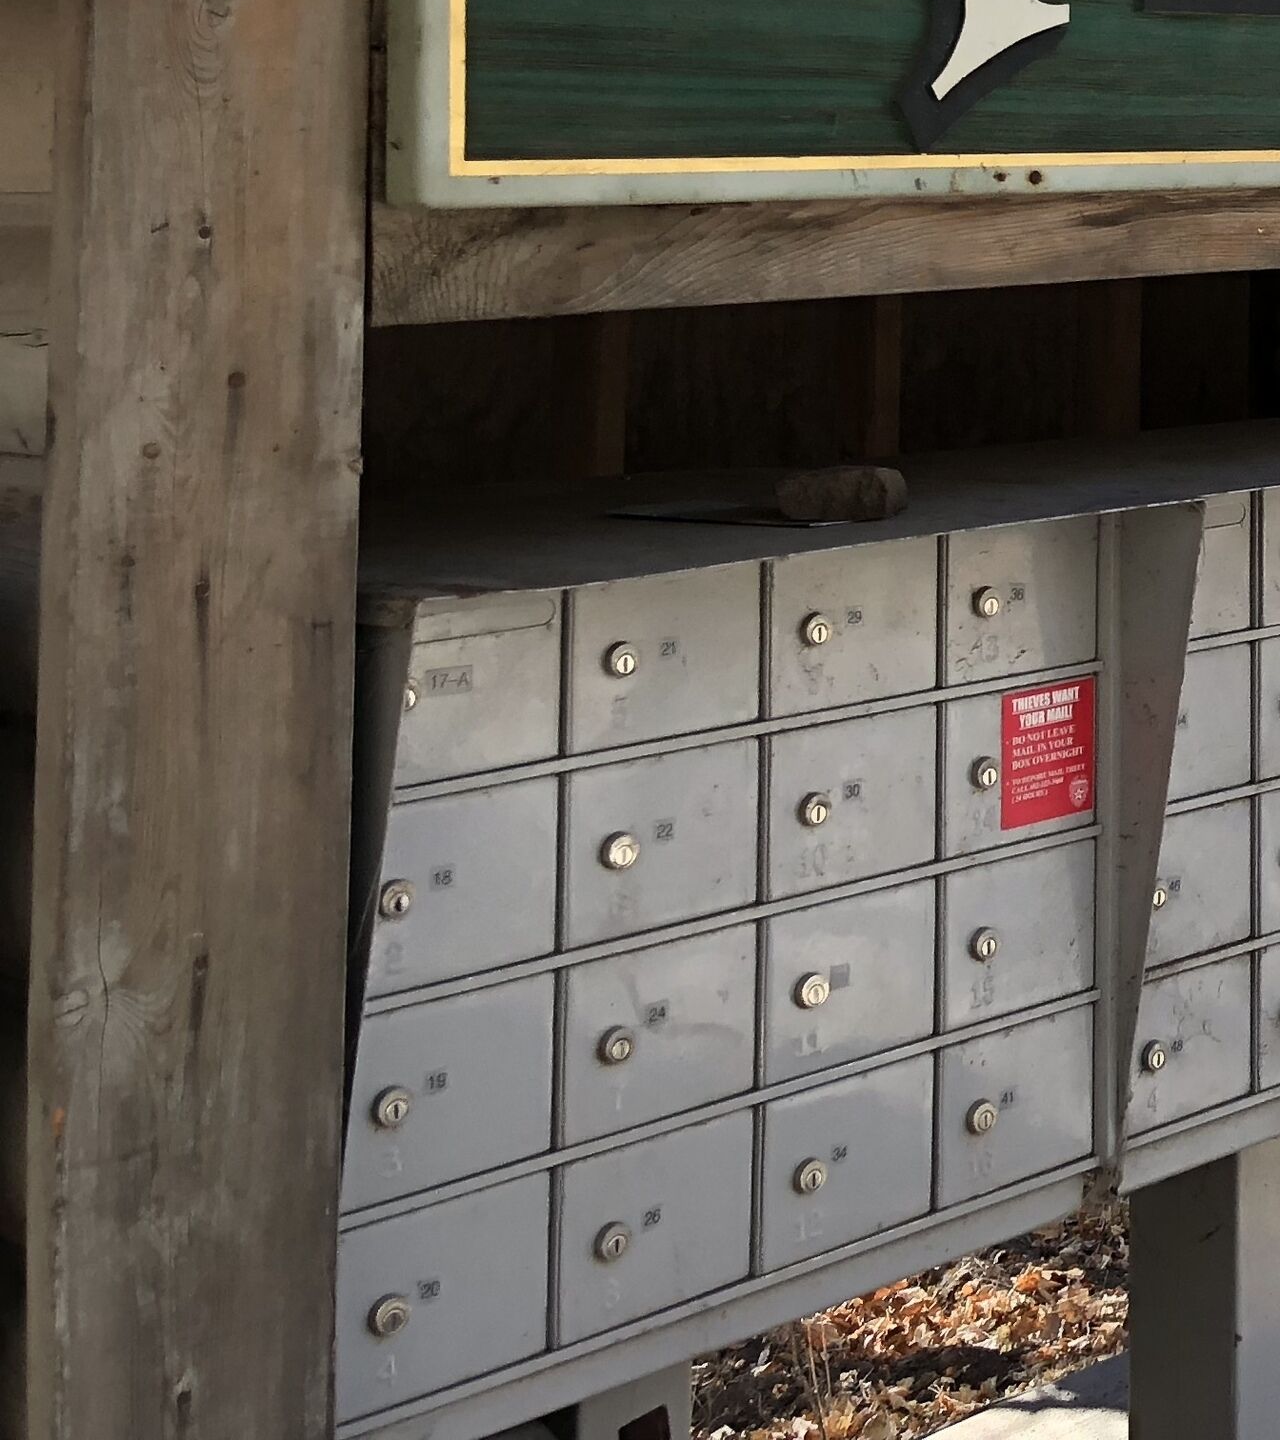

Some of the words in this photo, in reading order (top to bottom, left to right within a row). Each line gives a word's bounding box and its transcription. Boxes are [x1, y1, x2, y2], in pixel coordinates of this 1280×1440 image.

[847, 610, 862, 625] 29
[431, 671, 469, 690] 17-A
[1012, 692, 1050, 713] THIEVES
[1052, 686, 1080, 704] WANT
[1019, 710, 1045, 729] YOUR
[1012, 735, 1025, 746] DO
[1027, 730, 1046, 741] NOT
[1047, 724, 1076, 738] LEAVE
[1013, 745, 1035, 757] MAIL
[1037, 742, 1047, 753] IN
[1049, 737, 1073, 750] YOUR
[1012, 759, 1030, 771] BOX
[1032, 746, 1085, 764] OVERNIGHT
[844, 783, 860, 800] 30
[656, 822, 674, 839] 22
[434, 870, 452, 886] 18
[1168, 879, 1181, 892] 46
[1170, 1039, 1184, 1053] 48
[1001, 1091, 1014, 1105] 41
[643, 1208, 661, 1227] 26
